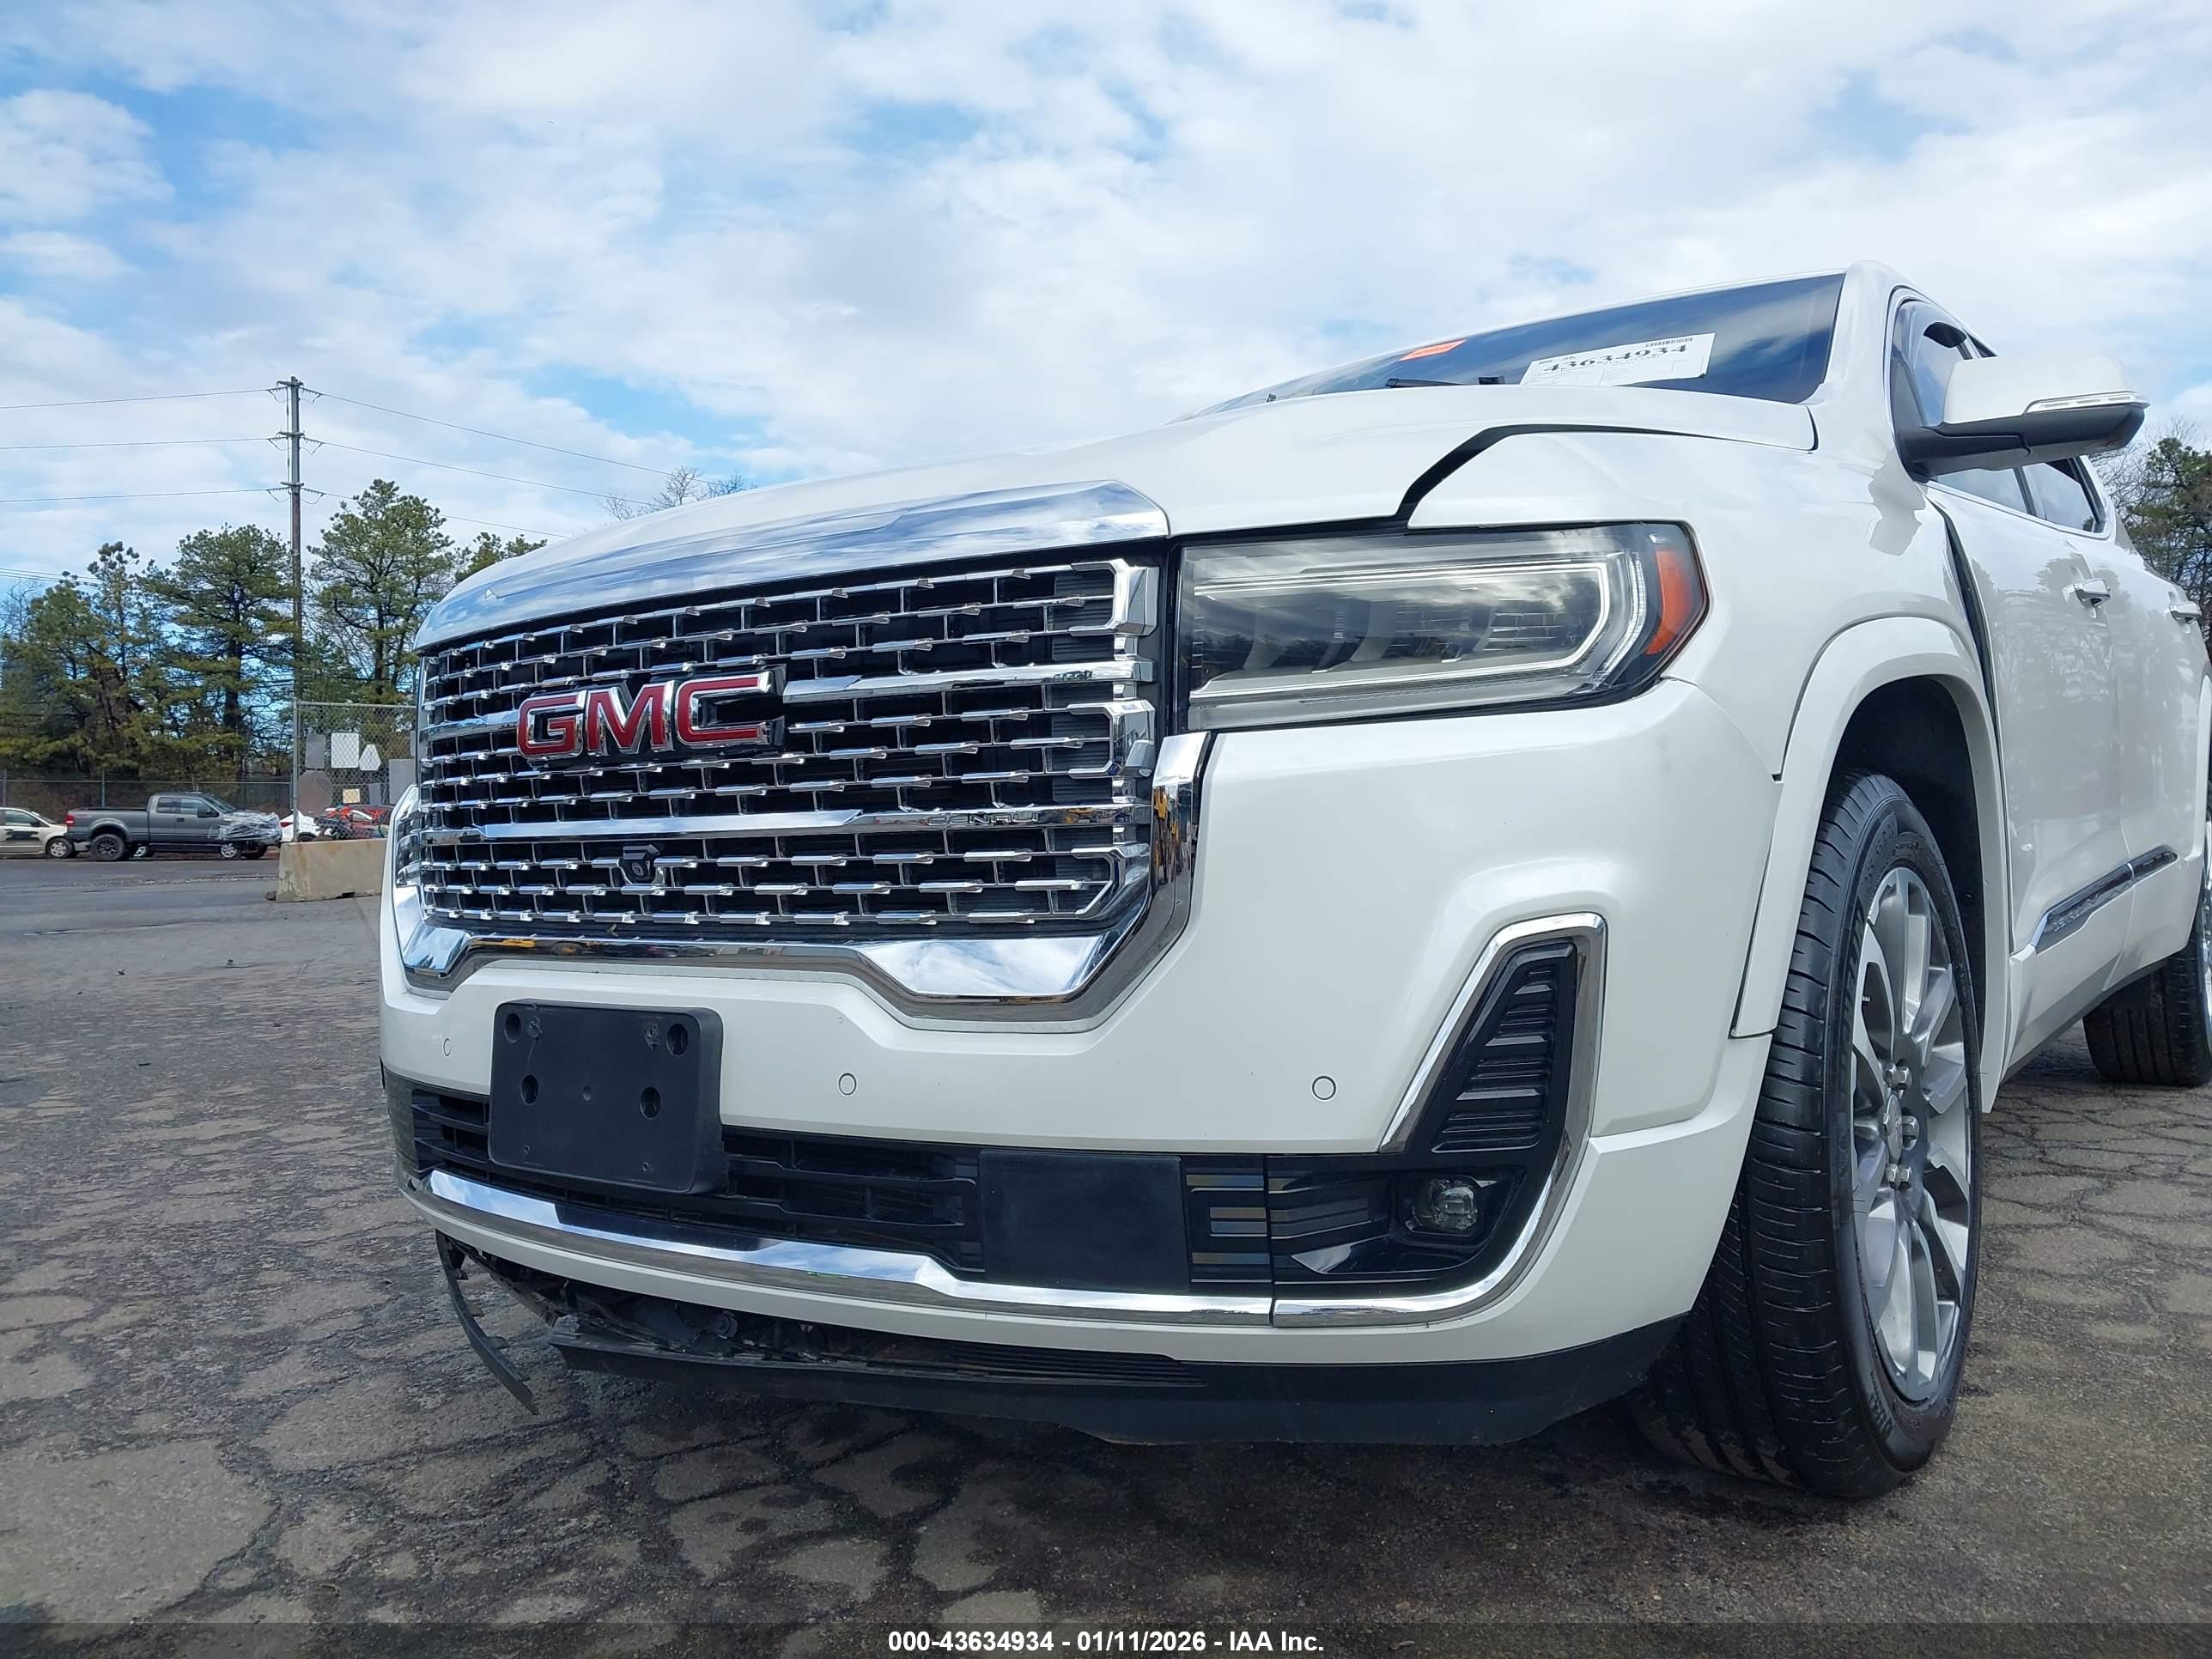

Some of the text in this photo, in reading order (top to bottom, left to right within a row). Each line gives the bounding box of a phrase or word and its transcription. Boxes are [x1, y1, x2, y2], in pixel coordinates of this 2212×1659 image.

[1544, 344, 1687, 372] 43634934
[517, 672, 773, 758] GMC
[928, 811, 1039, 825] DENALI
